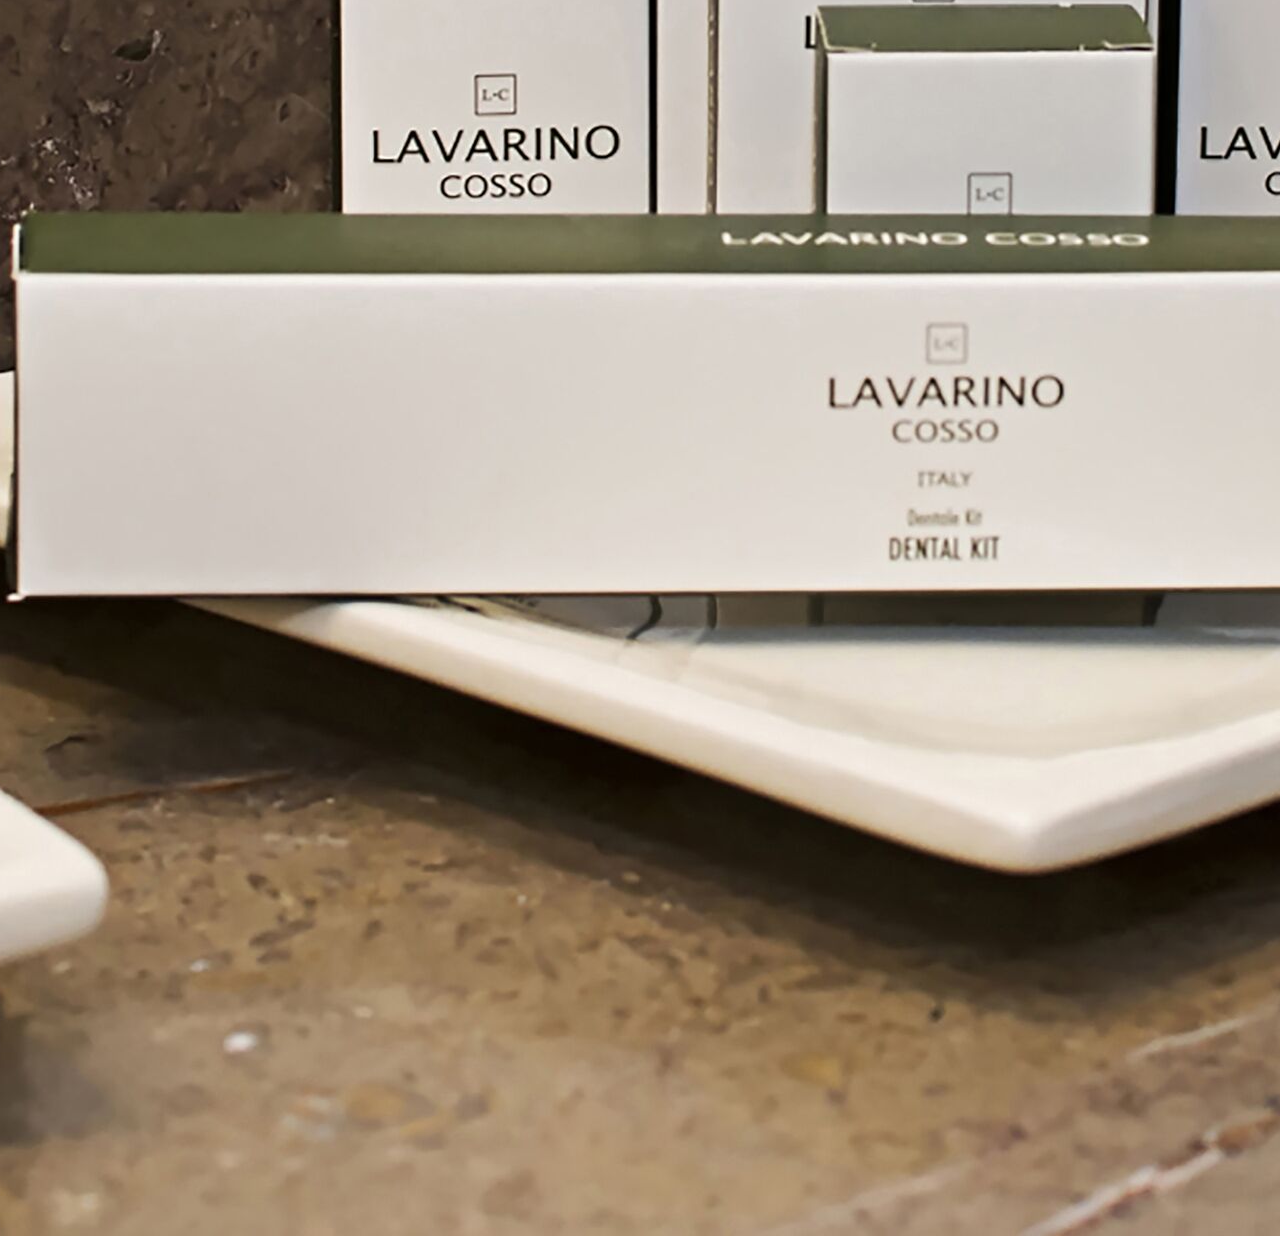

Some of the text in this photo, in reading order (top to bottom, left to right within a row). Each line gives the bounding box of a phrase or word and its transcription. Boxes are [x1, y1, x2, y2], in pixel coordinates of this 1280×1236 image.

[372, 125, 621, 164] LAVARINO
[439, 172, 552, 200] COSSO
[721, 231, 1150, 247] LAVARINO COSSO
[828, 375, 1065, 409] LAVARINO
[891, 419, 1000, 444] COSSO
[917, 470, 972, 488] ITALY
[889, 535, 999, 561] DENTAL KIT
